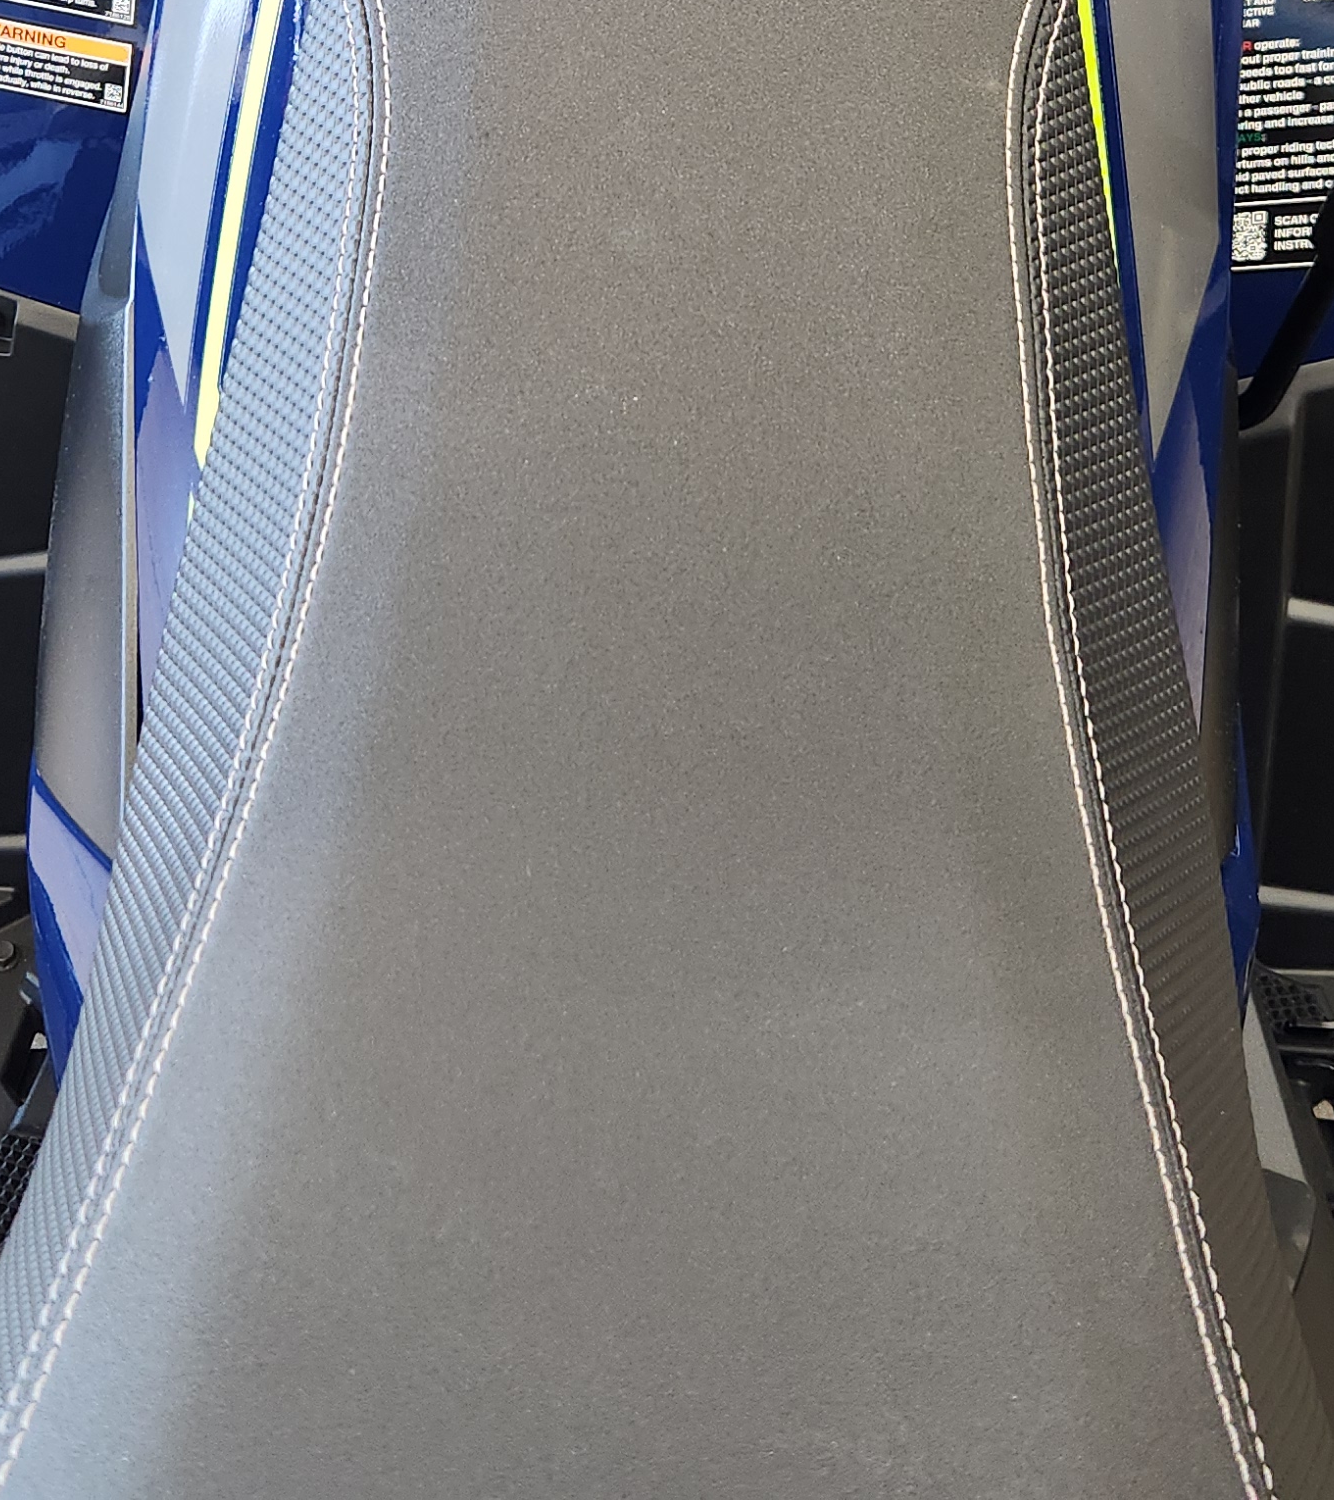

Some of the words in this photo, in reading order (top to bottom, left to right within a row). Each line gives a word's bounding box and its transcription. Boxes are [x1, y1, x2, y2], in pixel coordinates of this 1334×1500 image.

[1263, 51, 1300, 64] proper
[1274, 64, 1293, 75] too
[1294, 61, 1315, 73] fast
[1272, 76, 1305, 88] roads
[1263, 89, 1304, 102] vehicle
[1253, 104, 1311, 118] passenger
[1264, 117, 1285, 128] and
[1288, 113, 1334, 127] increase
[1241, 144, 1279, 157] proper
[1280, 140, 1314, 154] riding
[1273, 157, 1288, 166] on
[1251, 168, 1285, 182] paved
[1251, 180, 1300, 195] handling
[1301, 179, 1323, 190] and
[1274, 214, 1308, 226] SCAN
